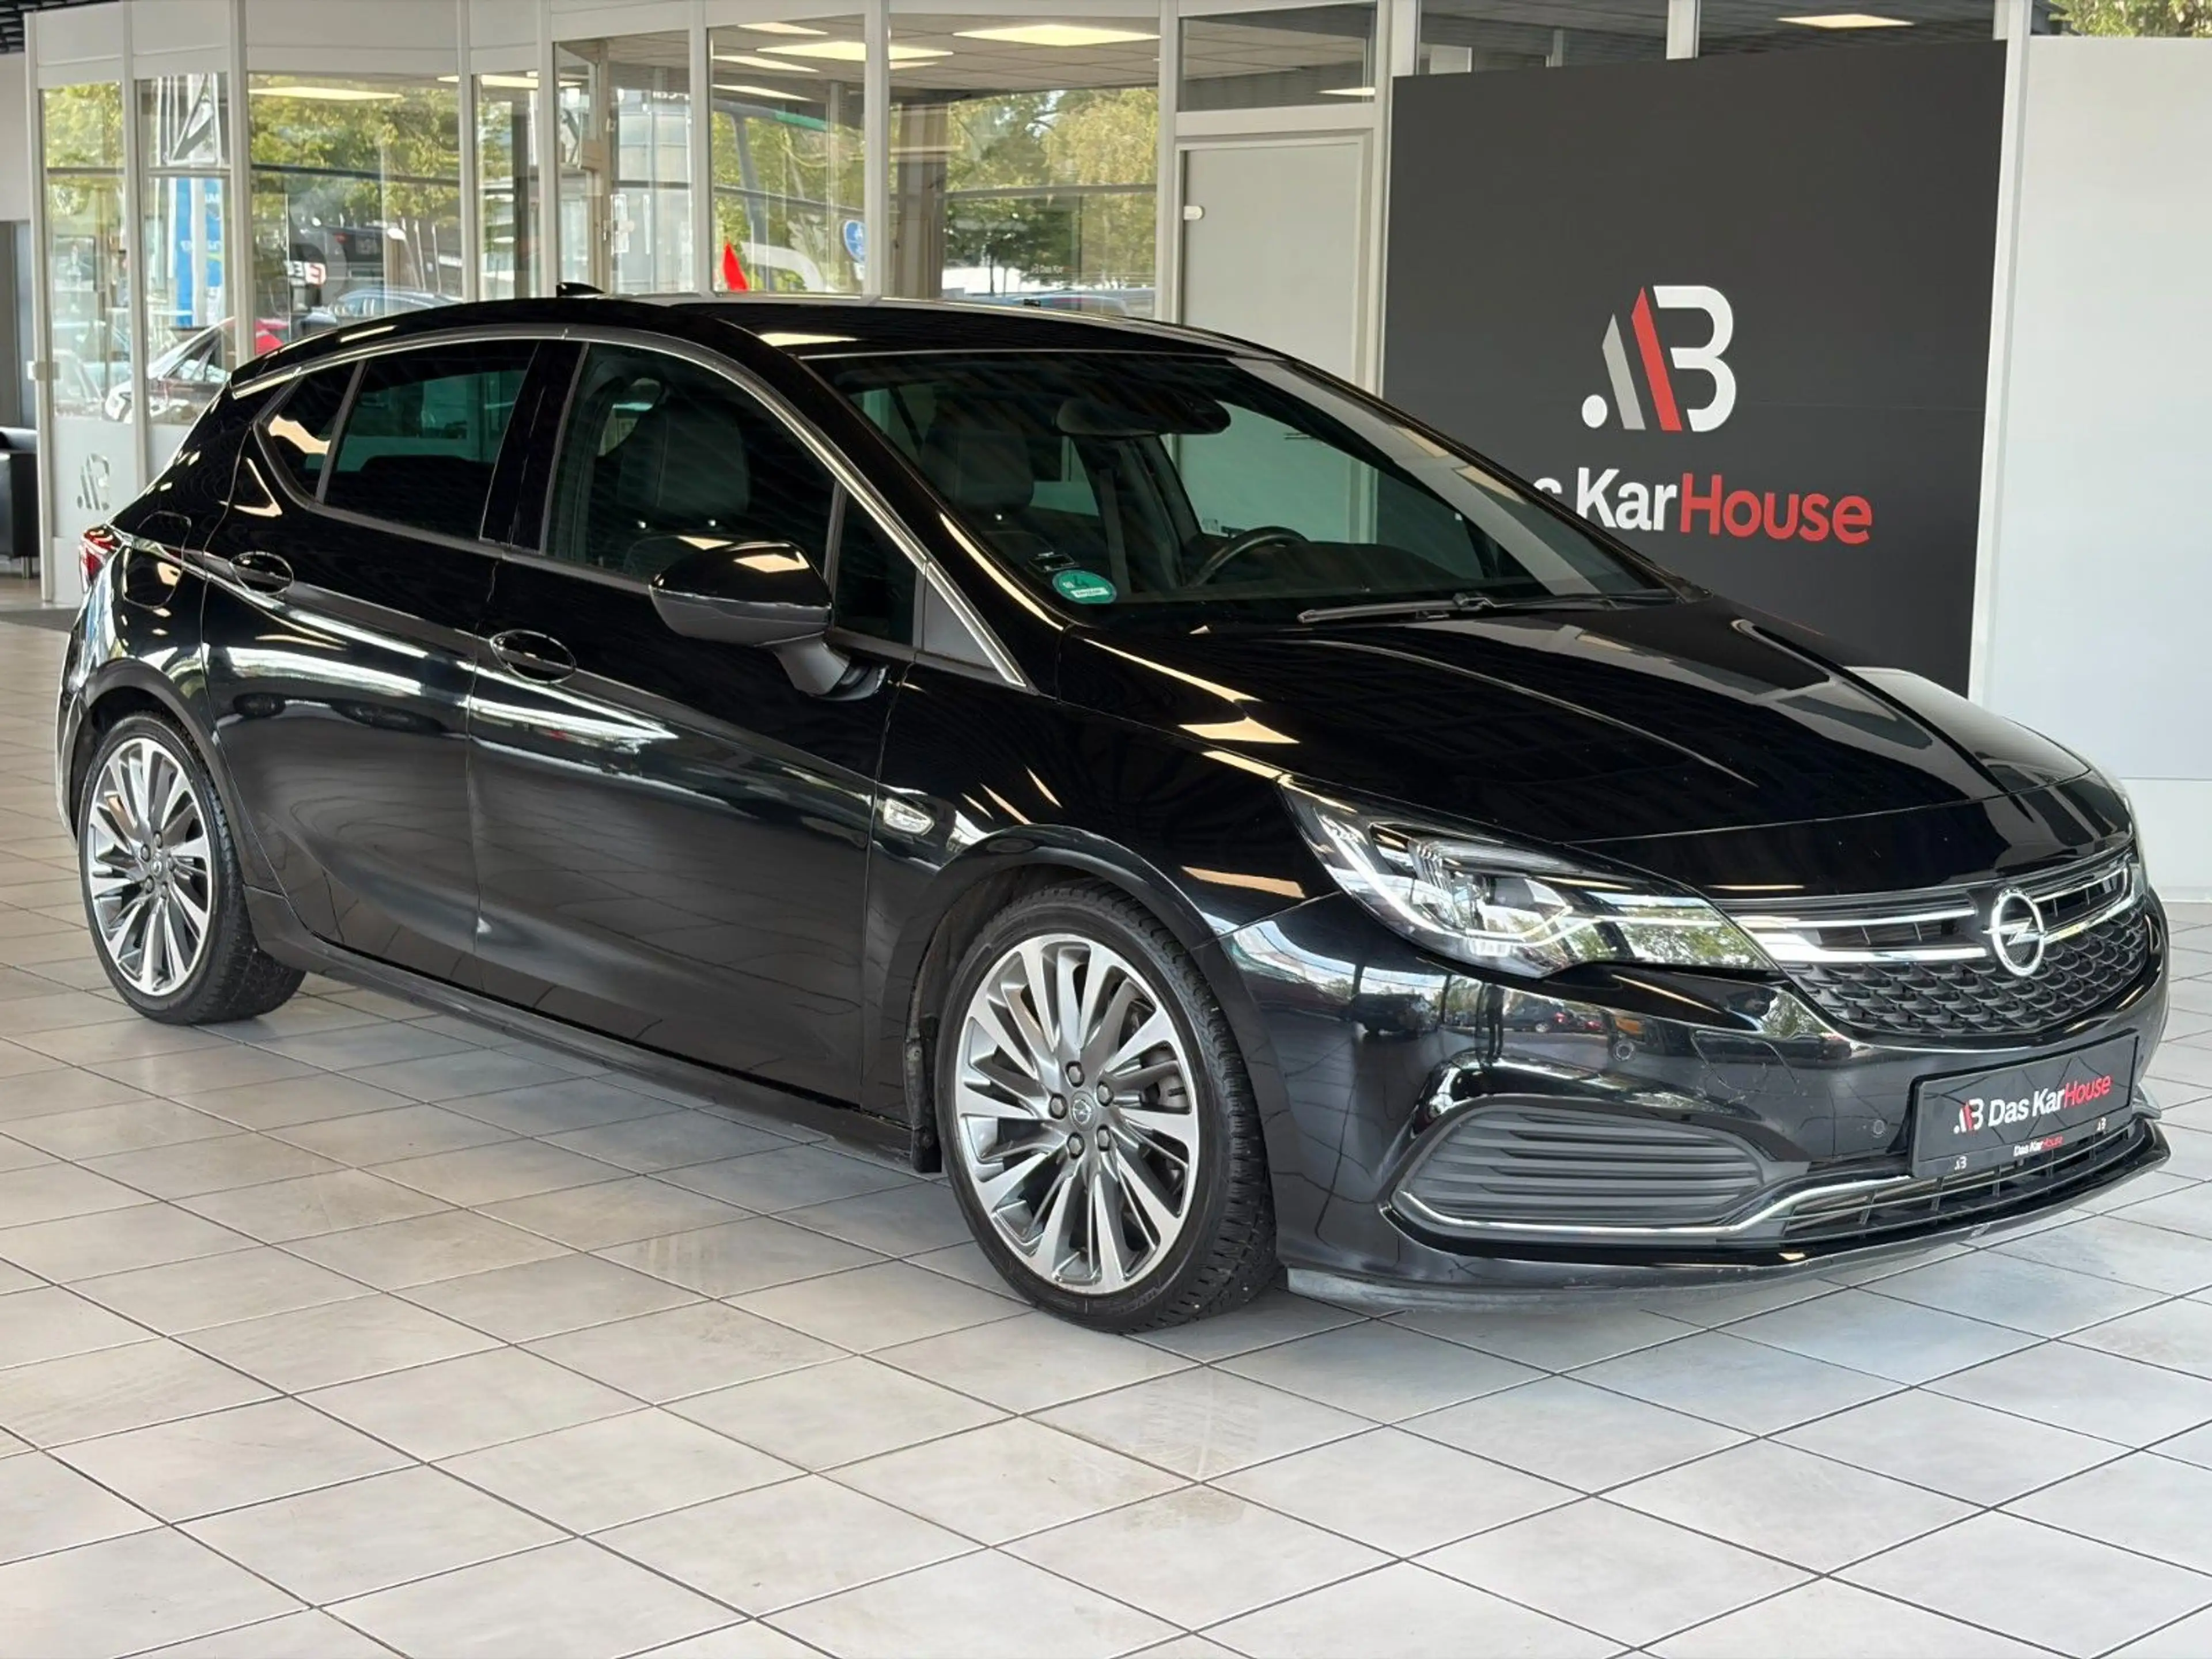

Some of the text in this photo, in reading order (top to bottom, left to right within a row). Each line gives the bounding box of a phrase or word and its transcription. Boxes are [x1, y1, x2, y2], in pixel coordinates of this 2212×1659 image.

[1577, 467, 1873, 544] KarHouse
[1988, 1099, 2030, 1127] Das
[2032, 1077, 2112, 1116] KarHouse
